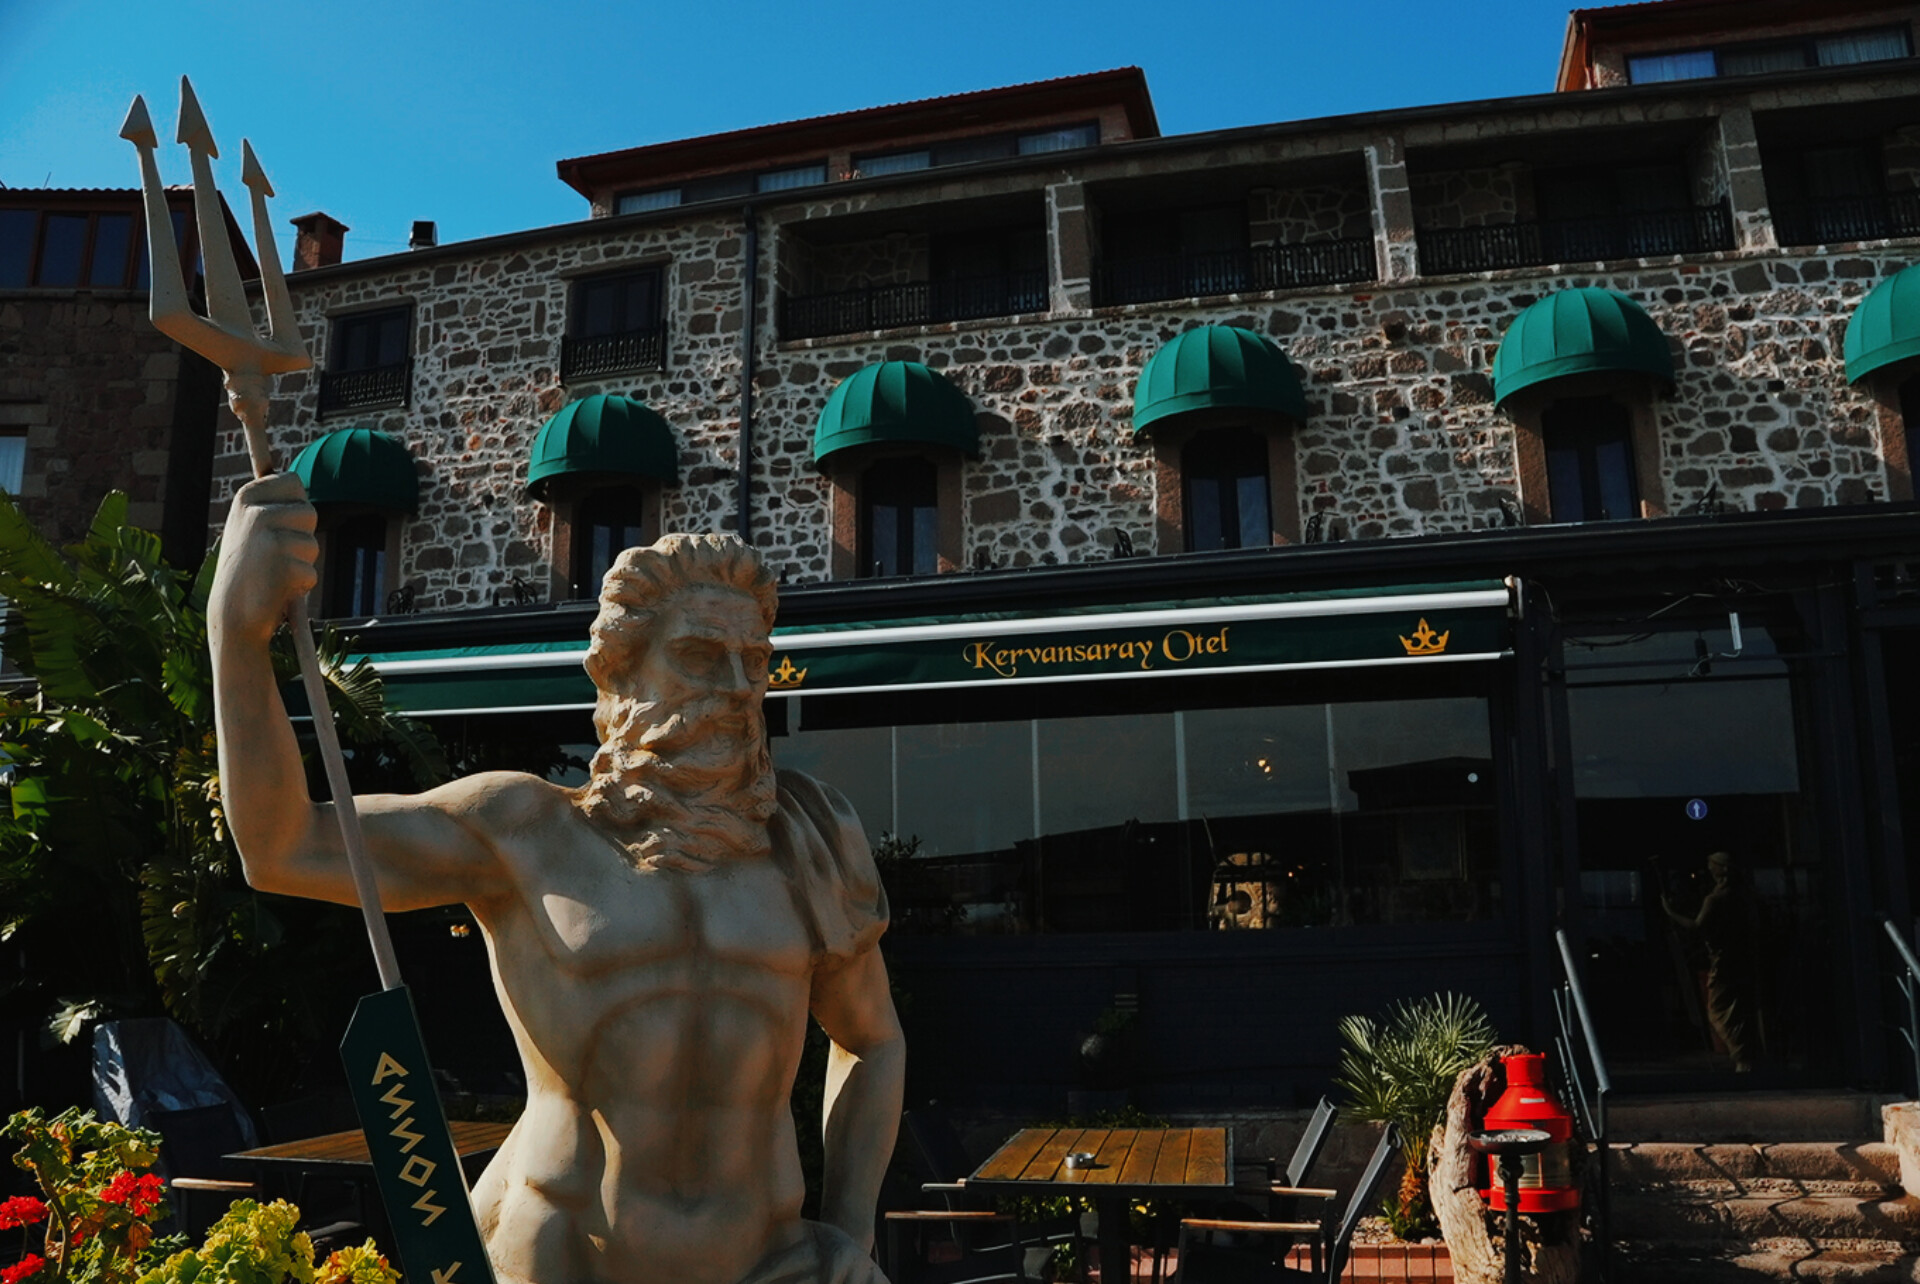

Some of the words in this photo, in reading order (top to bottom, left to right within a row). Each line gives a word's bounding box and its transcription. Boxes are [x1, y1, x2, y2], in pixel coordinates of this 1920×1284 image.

[963, 640, 1153, 677] Kervansaray
[1162, 627, 1229, 662] Otel
[371, 1052, 447, 1227] ASSOS
